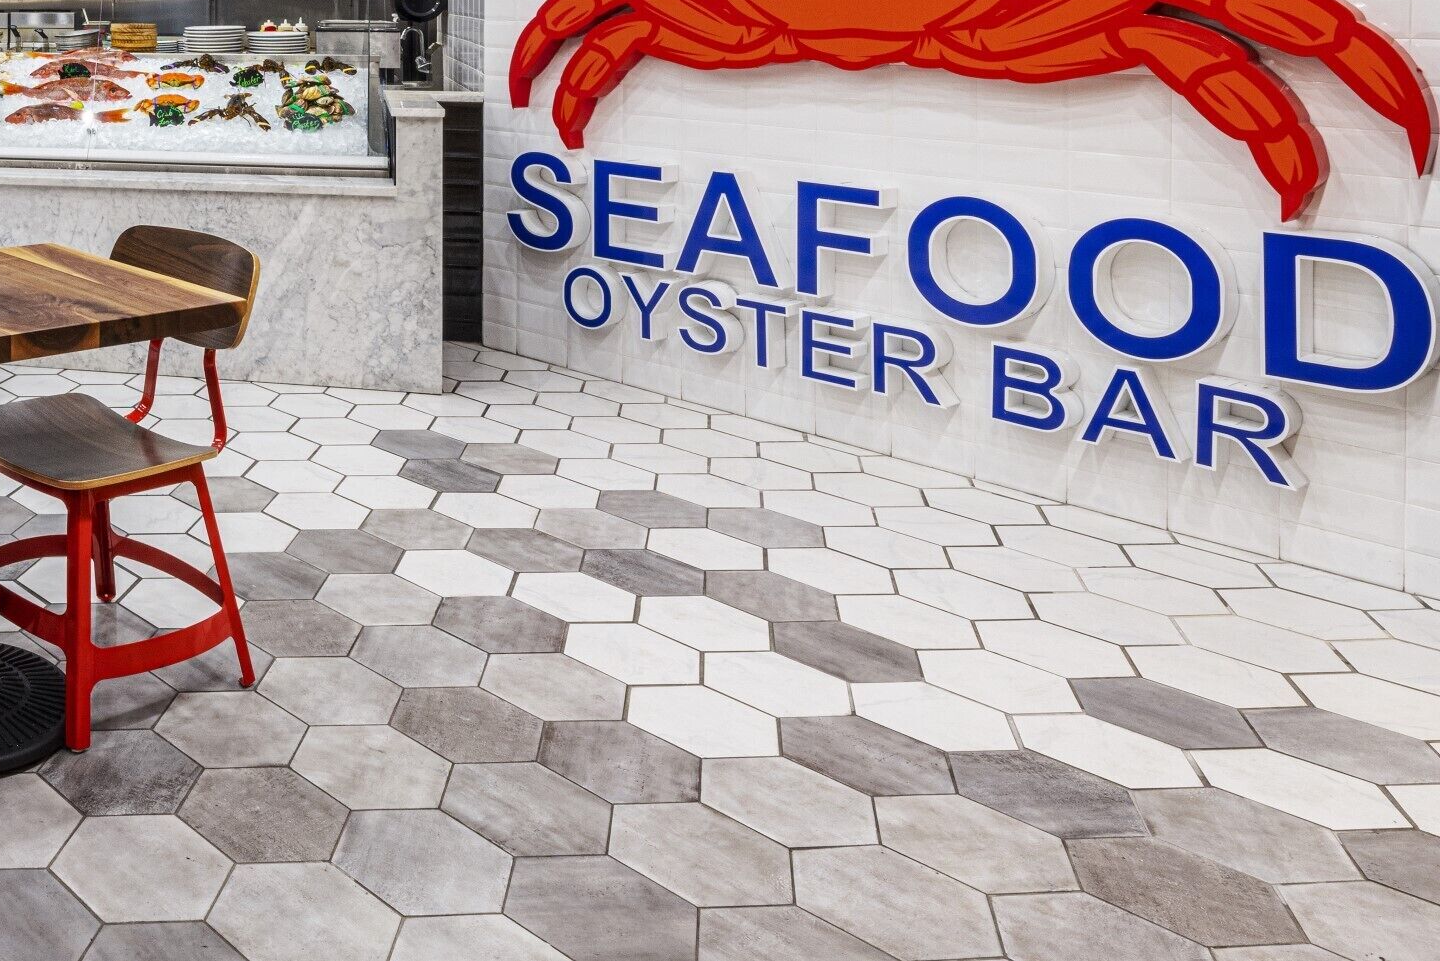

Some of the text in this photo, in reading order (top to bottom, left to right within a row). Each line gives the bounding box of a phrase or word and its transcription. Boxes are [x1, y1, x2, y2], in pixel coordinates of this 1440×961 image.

[507, 149, 1435, 393] SEAFOOD
[562, 266, 1289, 487] OYSTER BAR
